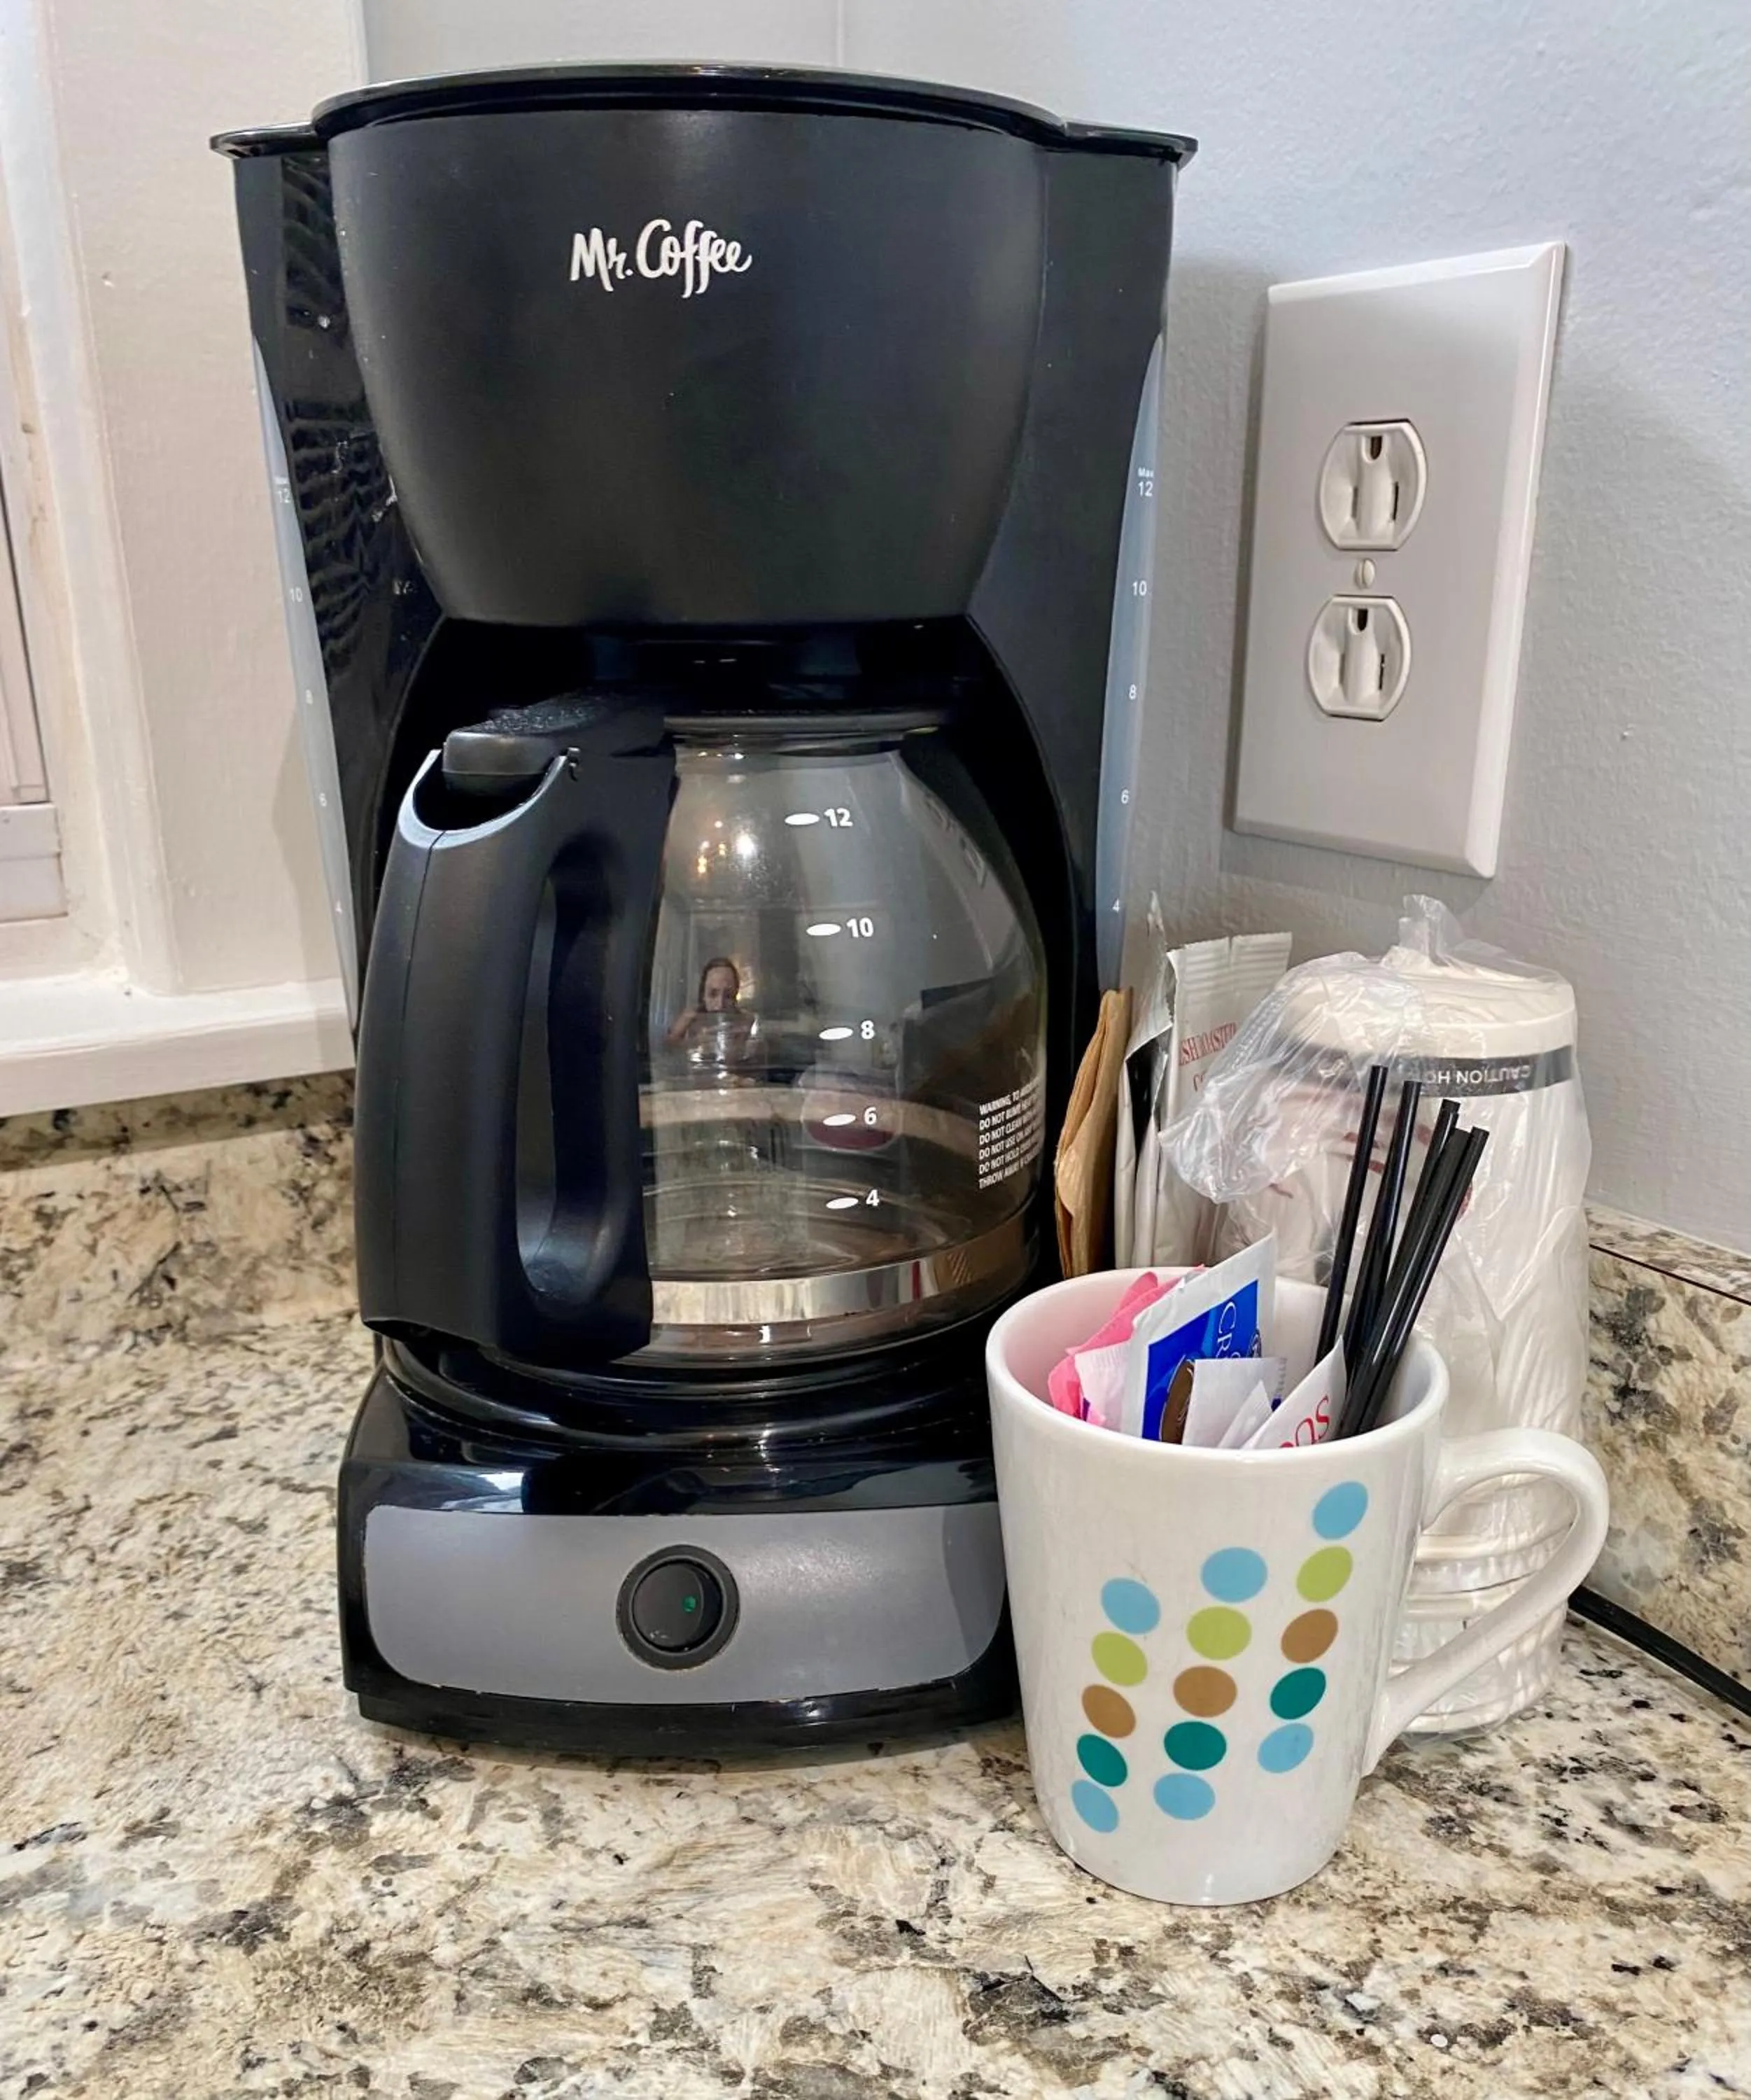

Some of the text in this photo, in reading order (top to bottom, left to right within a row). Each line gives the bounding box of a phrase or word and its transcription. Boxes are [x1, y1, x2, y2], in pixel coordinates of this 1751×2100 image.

[570, 219, 752, 299] Mr. Coffee
[1138, 481, 1153, 497] 12
[289, 587, 303, 603] 10
[1132, 580, 1148, 596] 10
[1129, 684, 1137, 700] 8
[1121, 790, 1129, 804] 6
[824, 808, 853, 827] 12
[1112, 898, 1120, 913] 4
[846, 917, 874, 937] 10
[861, 1020, 875, 1040] 8
[1456, 1065, 1532, 1085] CAUTION
[864, 1107, 878, 1125] 6
[979, 1118, 990, 1131] DO
[991, 1111, 1006, 1126] NOT
[979, 1132, 990, 1145] DO
[991, 1126, 1006, 1141] NOT
[979, 1147, 990, 1160] DO
[991, 1140, 1005, 1156] NOT
[979, 1161, 990, 1175] DO
[991, 1155, 1005, 1170] NOT
[866, 1189, 880, 1208] 4
[1216, 1301, 1237, 1359] CR
